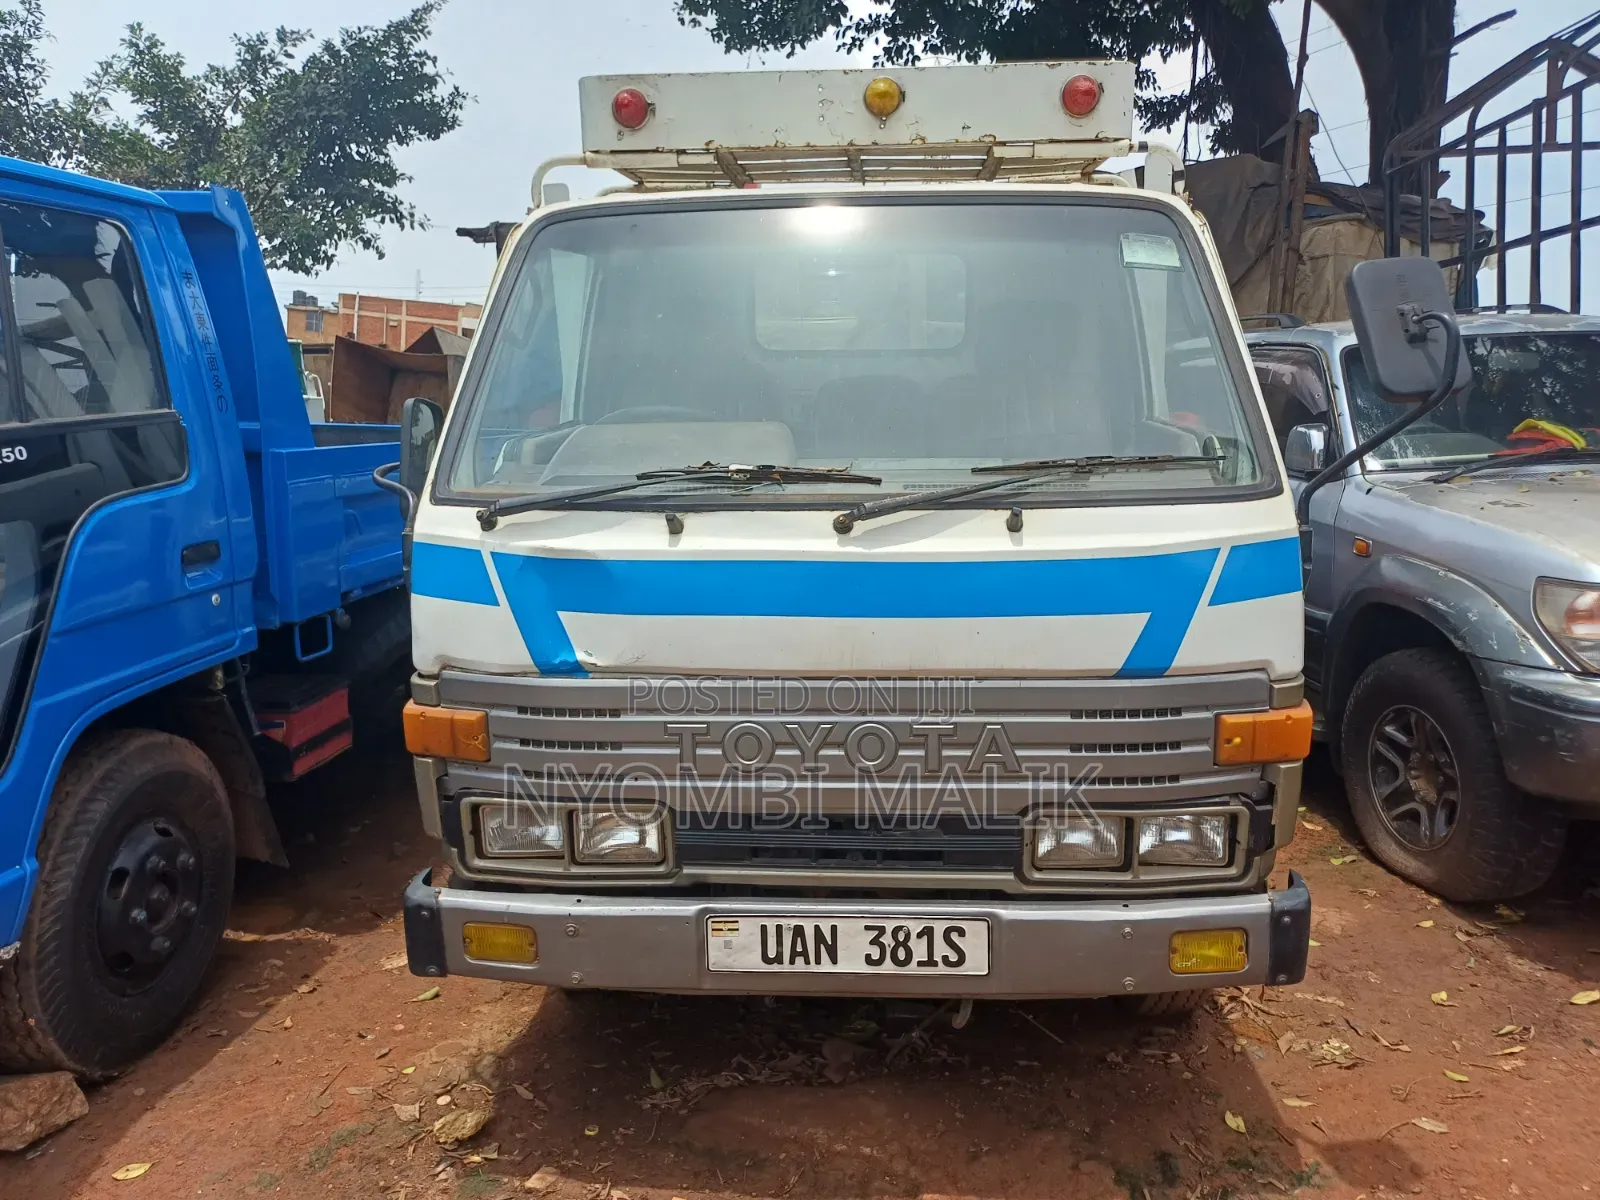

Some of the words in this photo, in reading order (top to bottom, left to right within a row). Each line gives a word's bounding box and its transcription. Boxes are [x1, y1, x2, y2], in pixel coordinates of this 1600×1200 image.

[0, 445, 28, 464] 50
[663, 721, 1023, 775] TOYOTA
[760, 924, 838, 965] UAN
[863, 925, 967, 968] 381S
